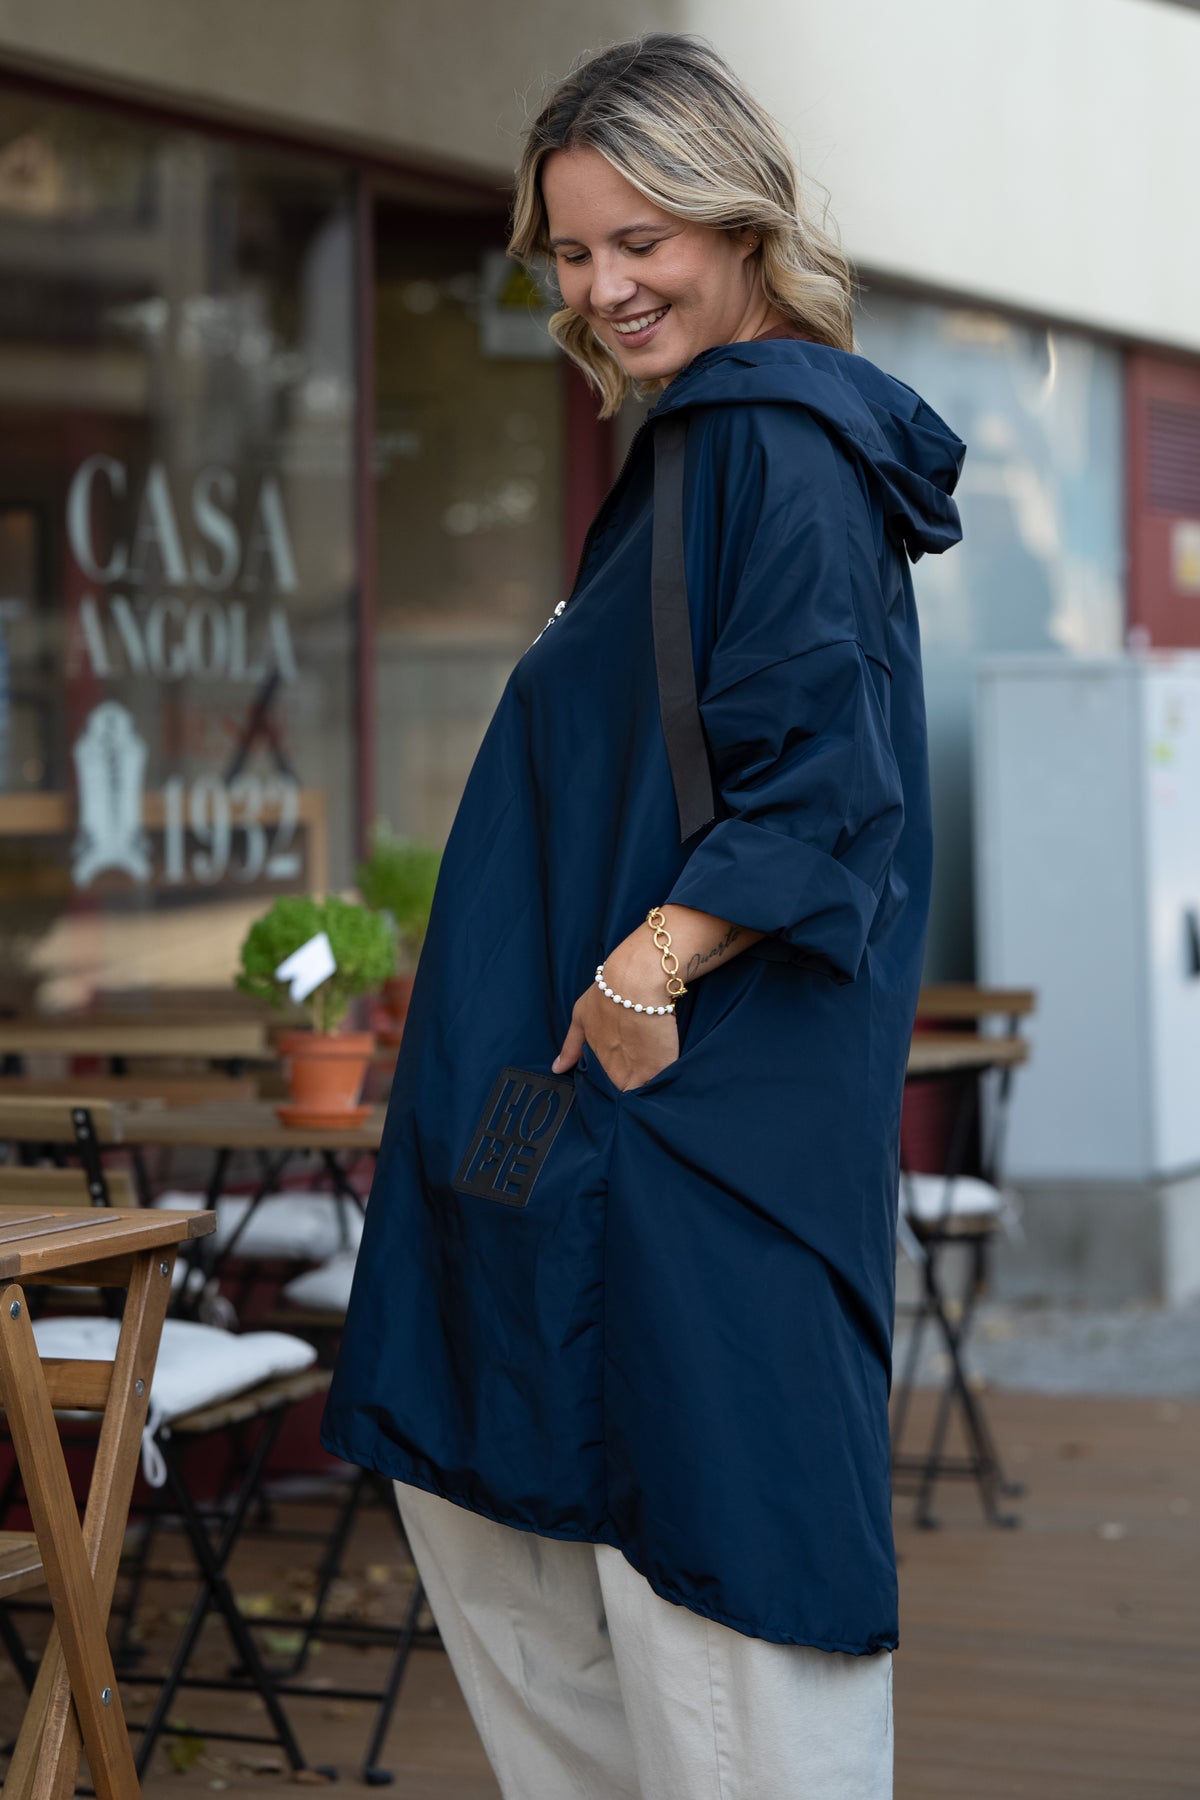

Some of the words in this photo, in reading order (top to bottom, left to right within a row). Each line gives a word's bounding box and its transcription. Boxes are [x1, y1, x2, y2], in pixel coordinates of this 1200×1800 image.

[67, 454, 298, 592] CASA
[66, 595, 298, 683] ANGOLA
[163, 776, 301, 885] 1932
